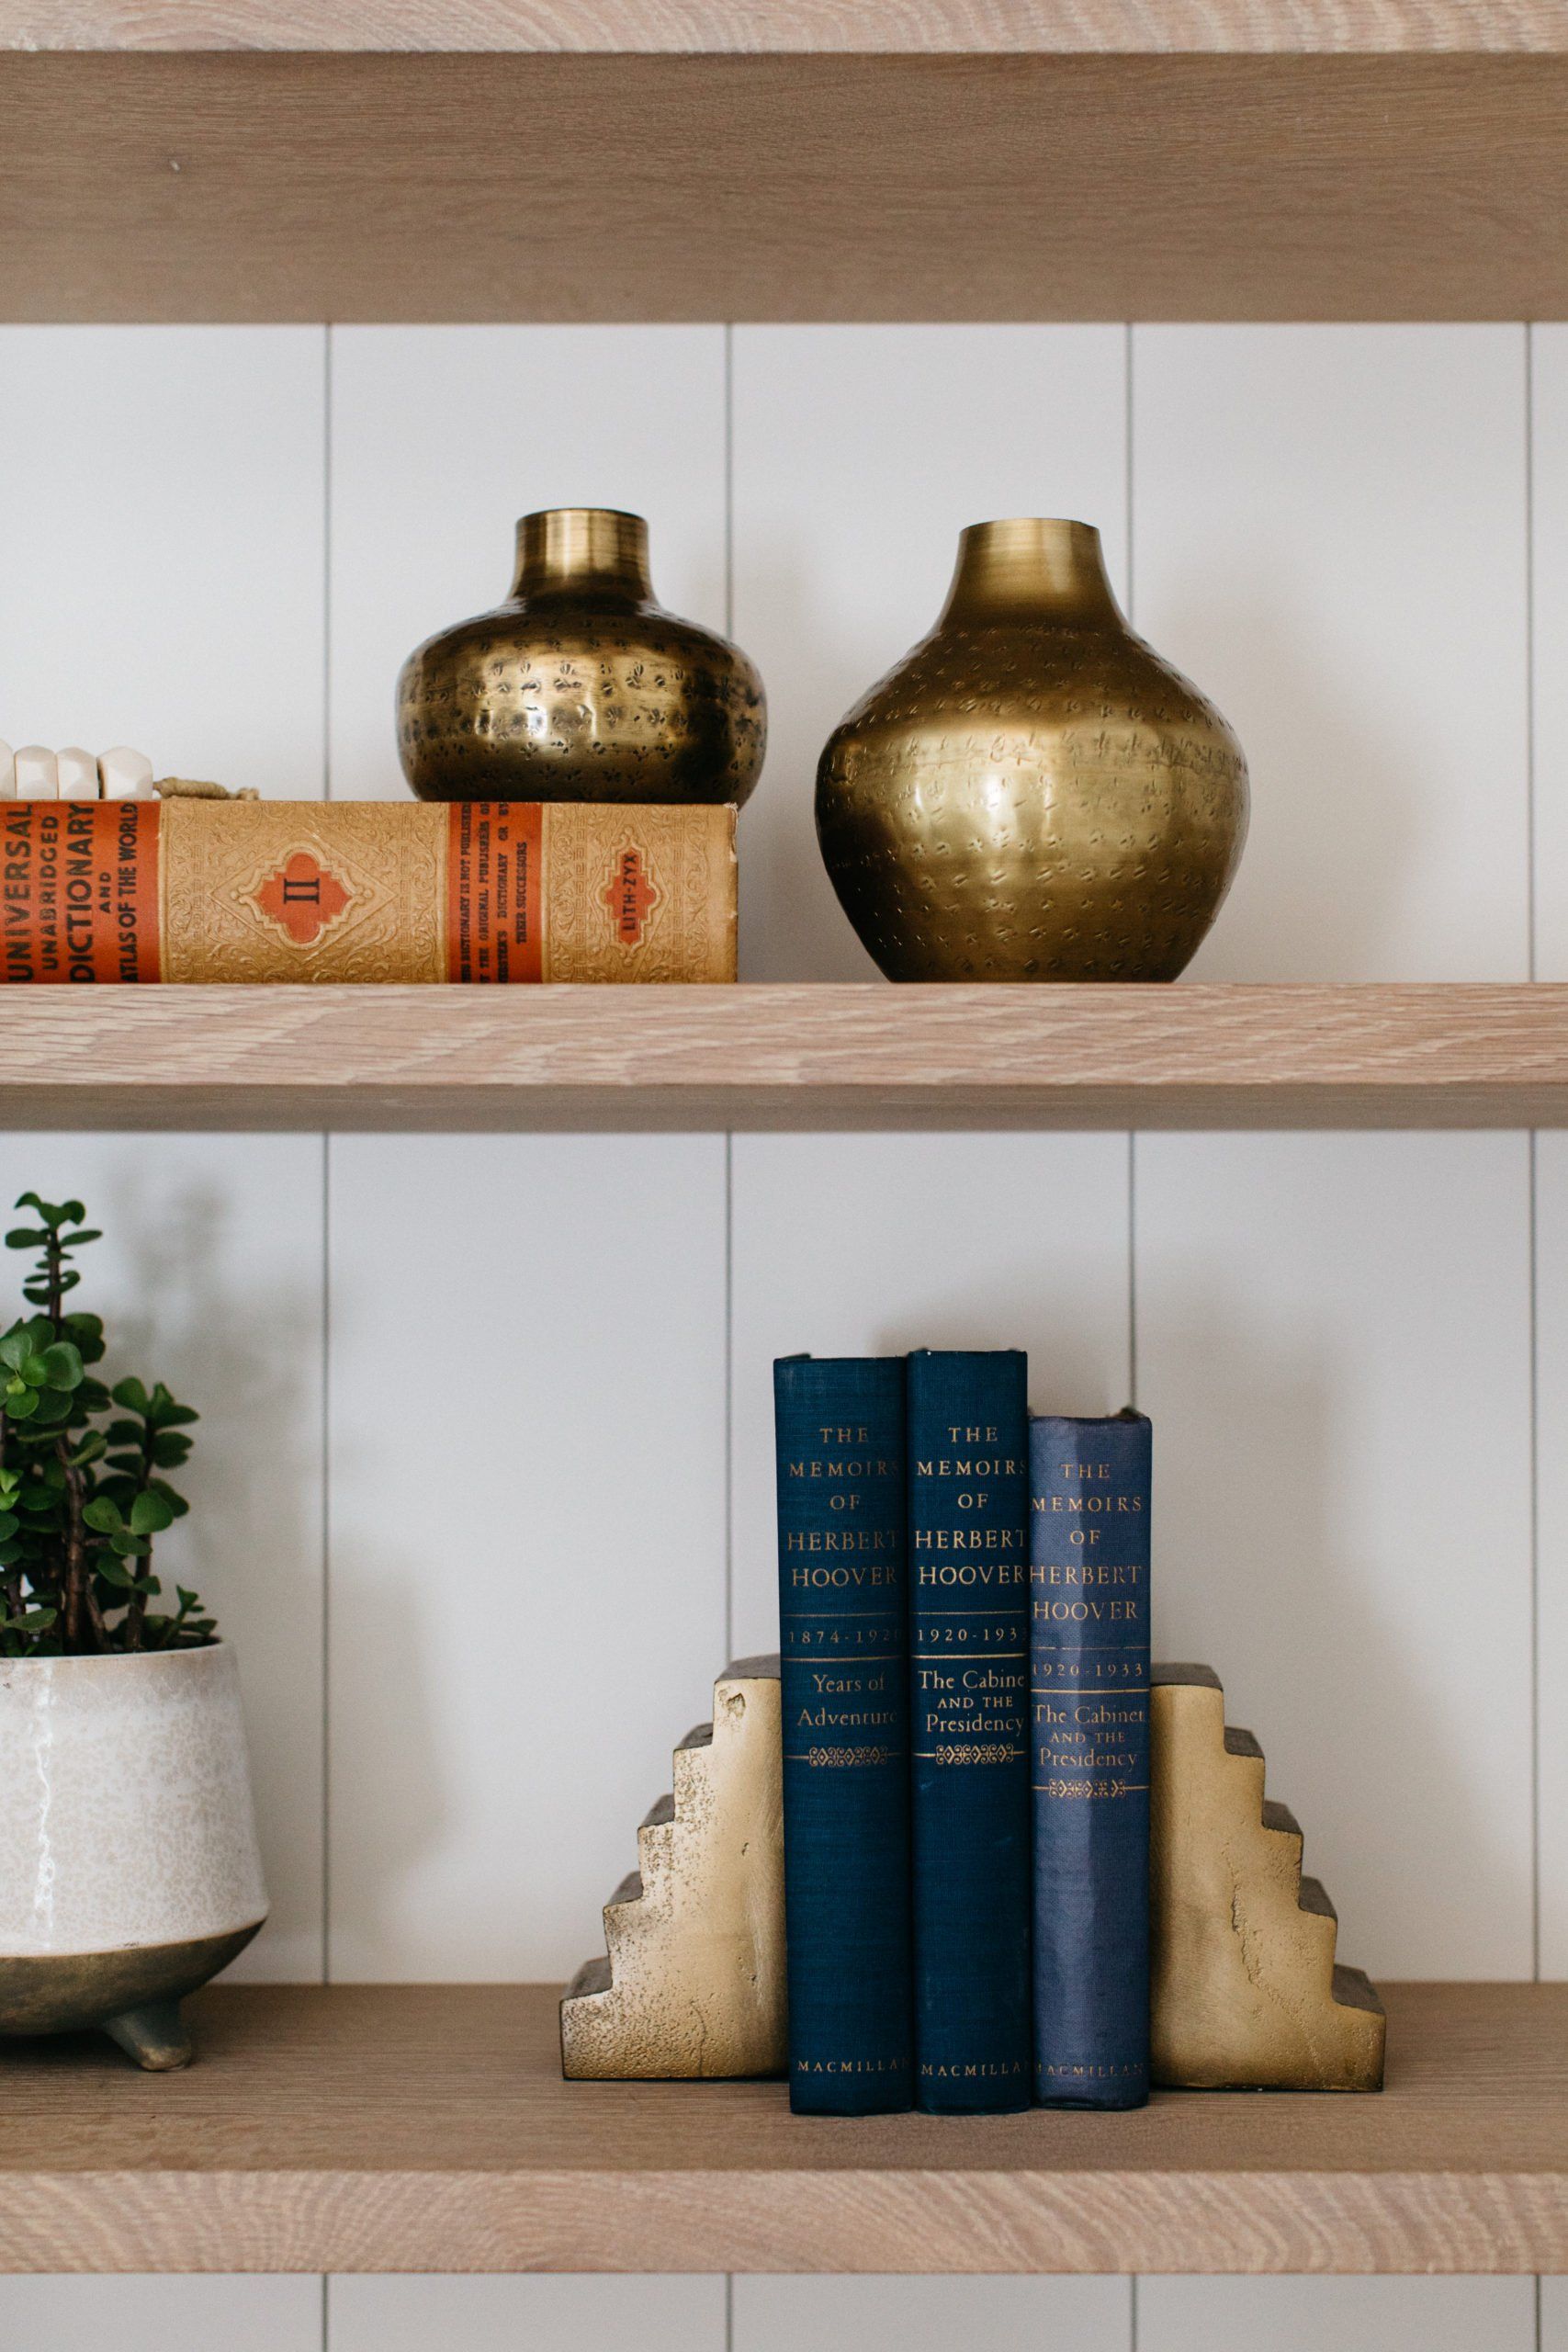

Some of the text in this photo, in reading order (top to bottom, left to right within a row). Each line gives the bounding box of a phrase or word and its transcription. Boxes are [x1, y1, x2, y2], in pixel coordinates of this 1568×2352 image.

[498, 826, 508, 841] OR
[479, 820, 490, 883] PUBLISHERS
[460, 859, 470, 880] NOT
[5, 804, 34, 981] UNIVERSAL
[39, 816, 59, 970] UNABRIDGED
[66, 803, 96, 983] DICTIONARY
[99, 872, 111, 914] AND
[118, 802, 138, 983] ATLAS OF THE WORLD
[283, 878, 320, 904] II
[460, 882, 470, 894] IS
[497, 854, 507, 918] DICTIONARY
[516, 842, 527, 944] THEIR SUCCESSORS
[623, 854, 637, 931] LITH-ZYX
[479, 889, 489, 941] ORIGINAL
[460, 897, 471, 961] DICTIONARY
[479, 947, 490, 968] THE
[819, 1428, 869, 1442] THE
[948, 1427, 998, 1442] THE
[1060, 1464, 1111, 1479] THE
[829, 1495, 860, 1510] OF
[957, 1493, 988, 1509] OF
[1031, 1497, 1142, 1512] MEMOIRS
[915, 1529, 1027, 1549] HERBERT
[1070, 1530, 1100, 1545] OF
[792, 1566, 897, 1587] HOOVER
[919, 1565, 1024, 1585] HOOVER
[1030, 1566, 1142, 1585] HERBERT
[1033, 1600, 1138, 1621] HOOVER
[919, 1669, 1025, 1690] The Cabine
[1033, 1663, 1144, 1678] 1920-1933
[812, 1671, 886, 1692] Years of
[938, 1696, 1013, 1709] AND THE
[1032, 1704, 1145, 1724] The Cabinet
[926, 1713, 1024, 1737] Presidency
[1049, 1732, 1125, 1744] AND THE
[1040, 1747, 1137, 1772] Presidency
